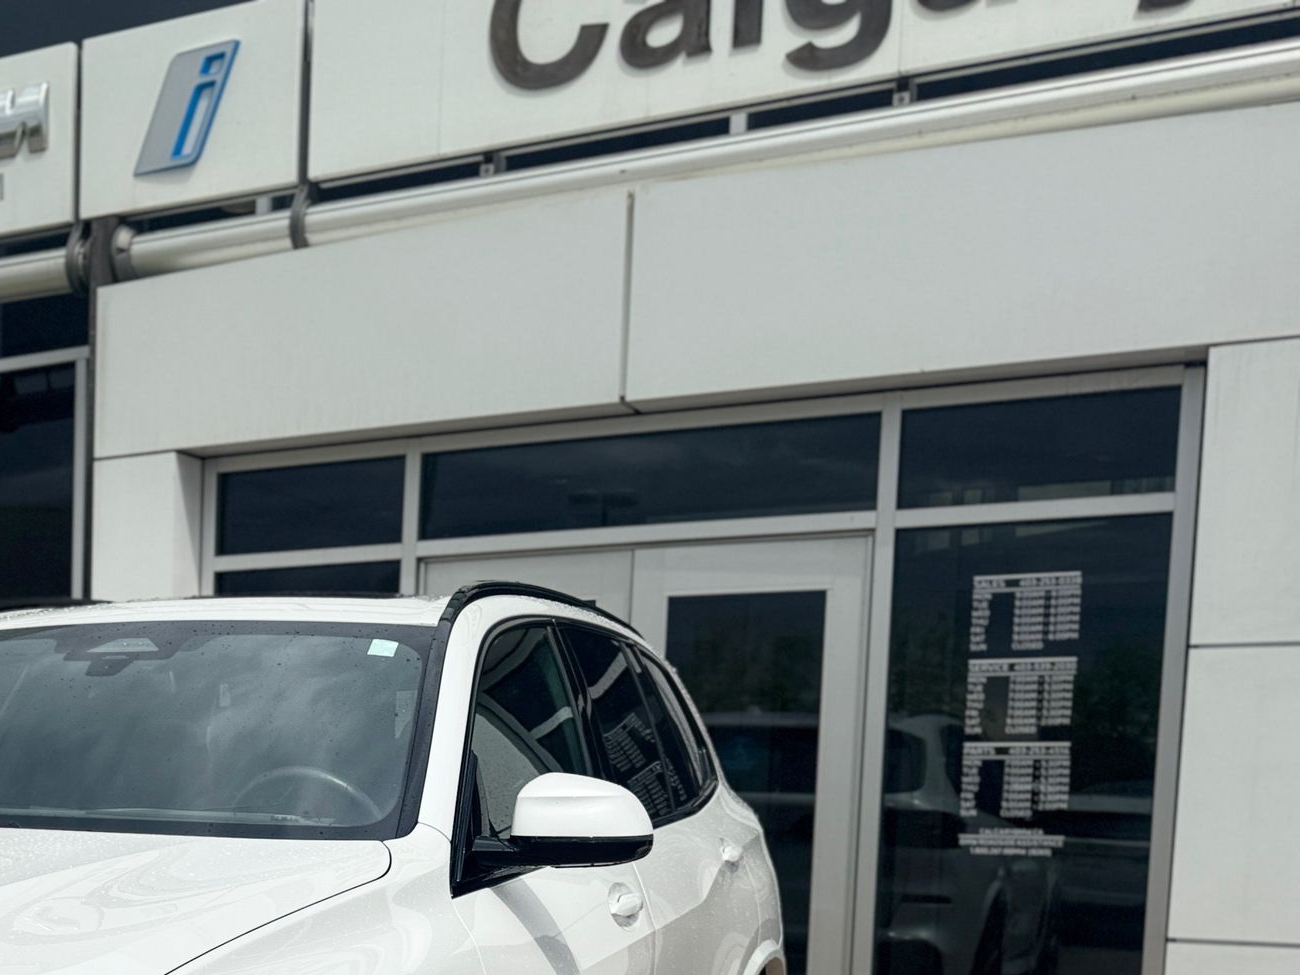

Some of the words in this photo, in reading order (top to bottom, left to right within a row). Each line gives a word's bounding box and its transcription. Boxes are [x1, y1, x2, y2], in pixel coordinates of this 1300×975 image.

[973, 579, 1006, 589] SALES
[968, 663, 1009, 673] SERVICE
[963, 747, 996, 755] PARTS
